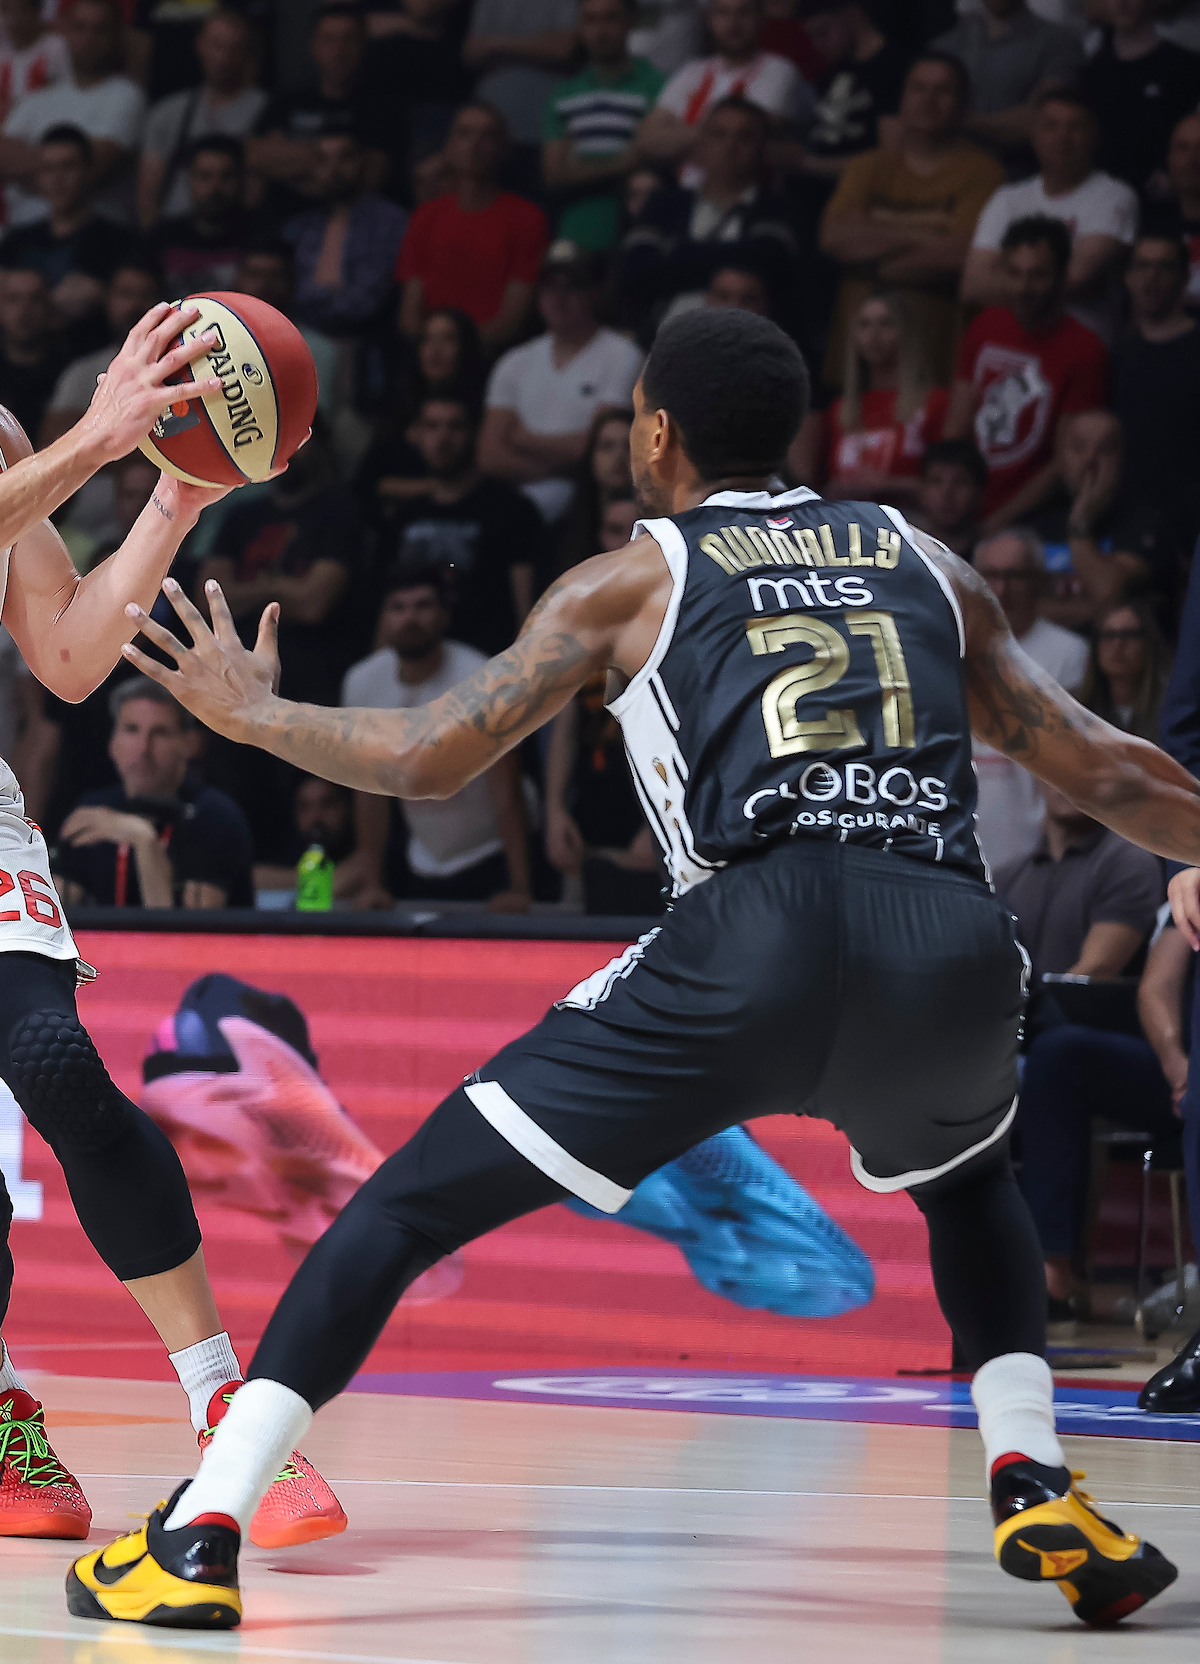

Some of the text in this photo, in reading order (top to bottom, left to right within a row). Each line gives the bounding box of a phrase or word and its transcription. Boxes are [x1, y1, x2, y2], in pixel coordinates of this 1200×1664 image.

[197, 322, 264, 450] PALDING
[746, 571, 874, 612] mts
[745, 611, 917, 758] 21
